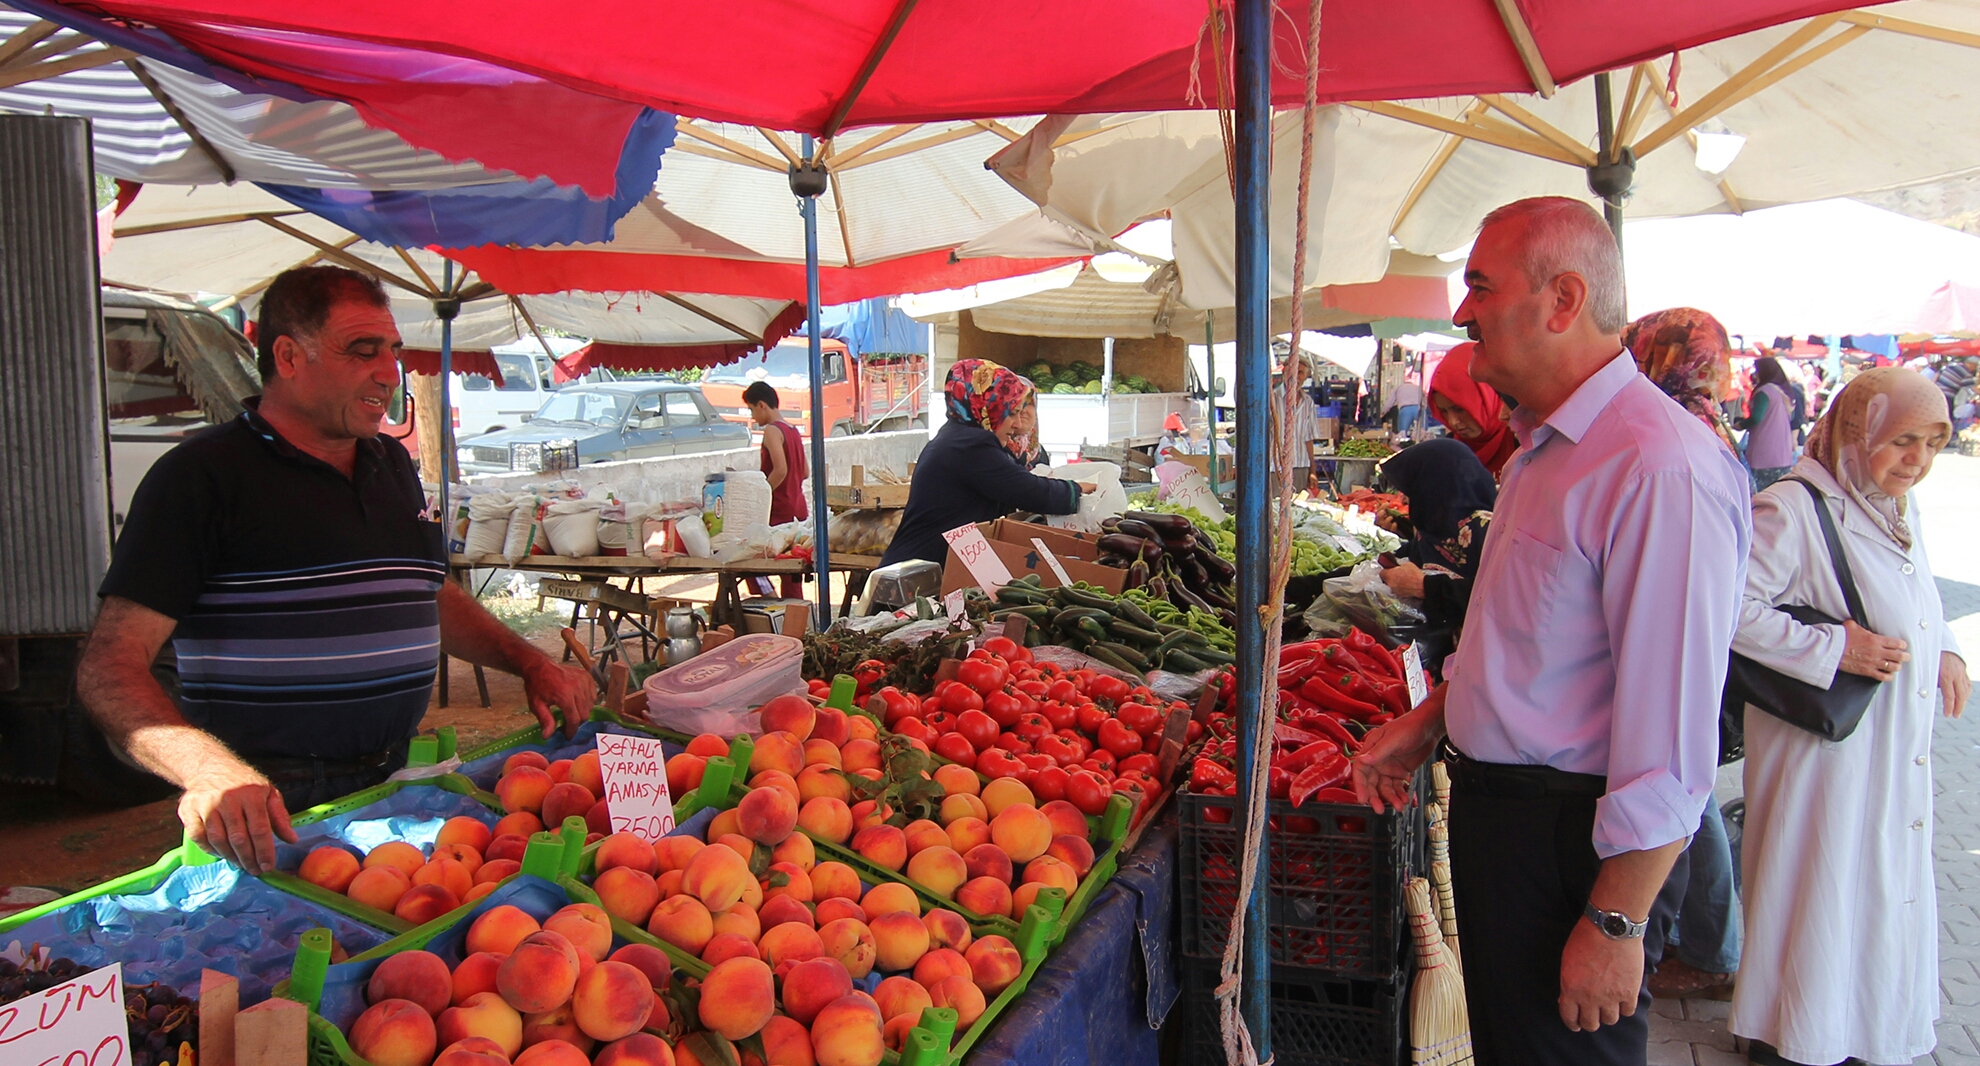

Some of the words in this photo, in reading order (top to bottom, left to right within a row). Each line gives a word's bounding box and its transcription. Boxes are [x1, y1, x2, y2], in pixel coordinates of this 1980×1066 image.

[1176, 488, 1192, 508] 3
[1195, 485, 1210, 498] TL
[960, 540, 987, 566] 1500
[684, 666, 727, 684] ROYAL
[602, 761, 660, 784] YARMA
[608, 780, 668, 806] AMASYA
